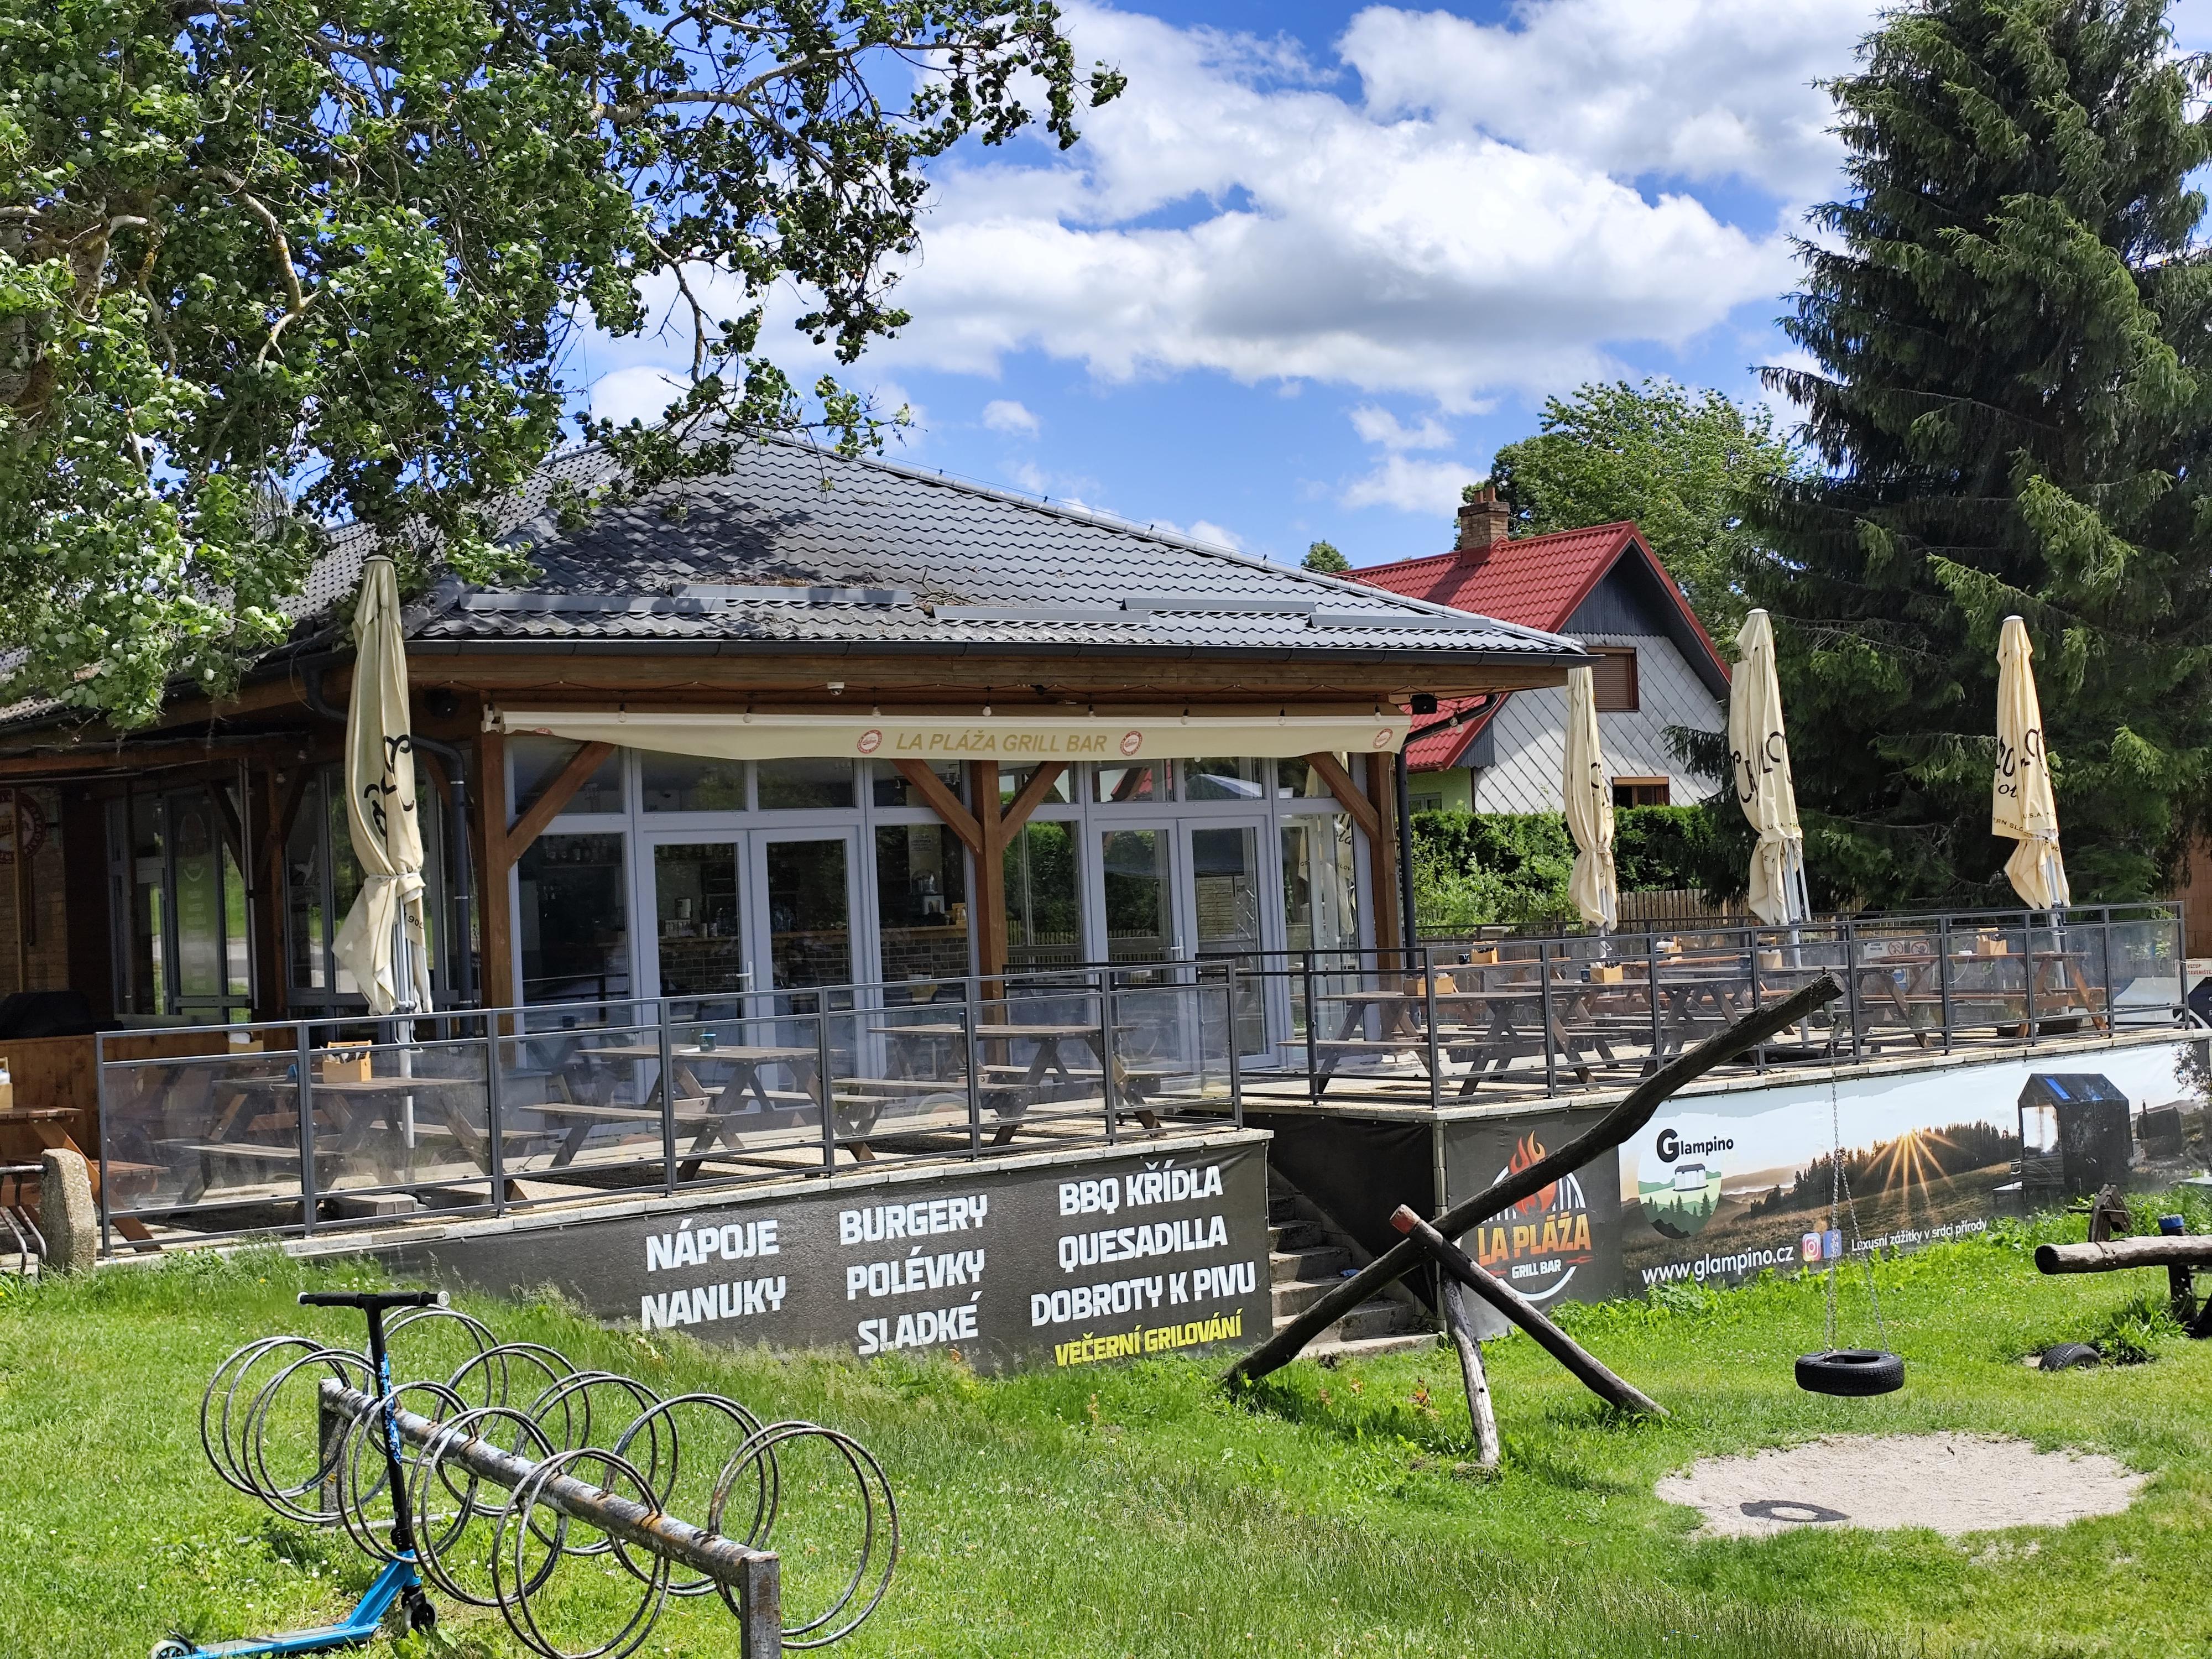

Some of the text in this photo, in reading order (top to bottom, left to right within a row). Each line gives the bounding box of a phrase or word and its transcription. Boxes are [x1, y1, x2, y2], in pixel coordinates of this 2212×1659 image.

[896, 733, 922, 750] LA
[929, 729, 996, 752] PLÁŽA
[1003, 734, 1060, 753] GRILL
[1066, 735, 1107, 753] BAR
[1657, 1128, 1734, 1163] Glampino
[1058, 1159, 1224, 1215] BBQ KŘÍDLA
[646, 1218, 780, 1272] NÁPOJE
[839, 1194, 988, 1245] BURGERY
[1058, 1215, 1228, 1273] QUESADILLA
[1477, 1211, 1592, 1267] LA PLÁŽA
[1851, 1218, 1987, 1251] Luxusní zážitky v srdci přírody
[847, 1245, 985, 1301] POLÉVKY
[1511, 1259, 1562, 1279] GRILL BAR
[1641, 1245, 1794, 1284] wwwglampino.cz
[641, 1275, 786, 1331] NANUKY
[1031, 1261, 1256, 1327] DOBROTY K PIVU
[858, 1290, 983, 1355] SLADKÉ
[1055, 1308, 1243, 1366] VEČERNÍ GRILOVÁNÍ
